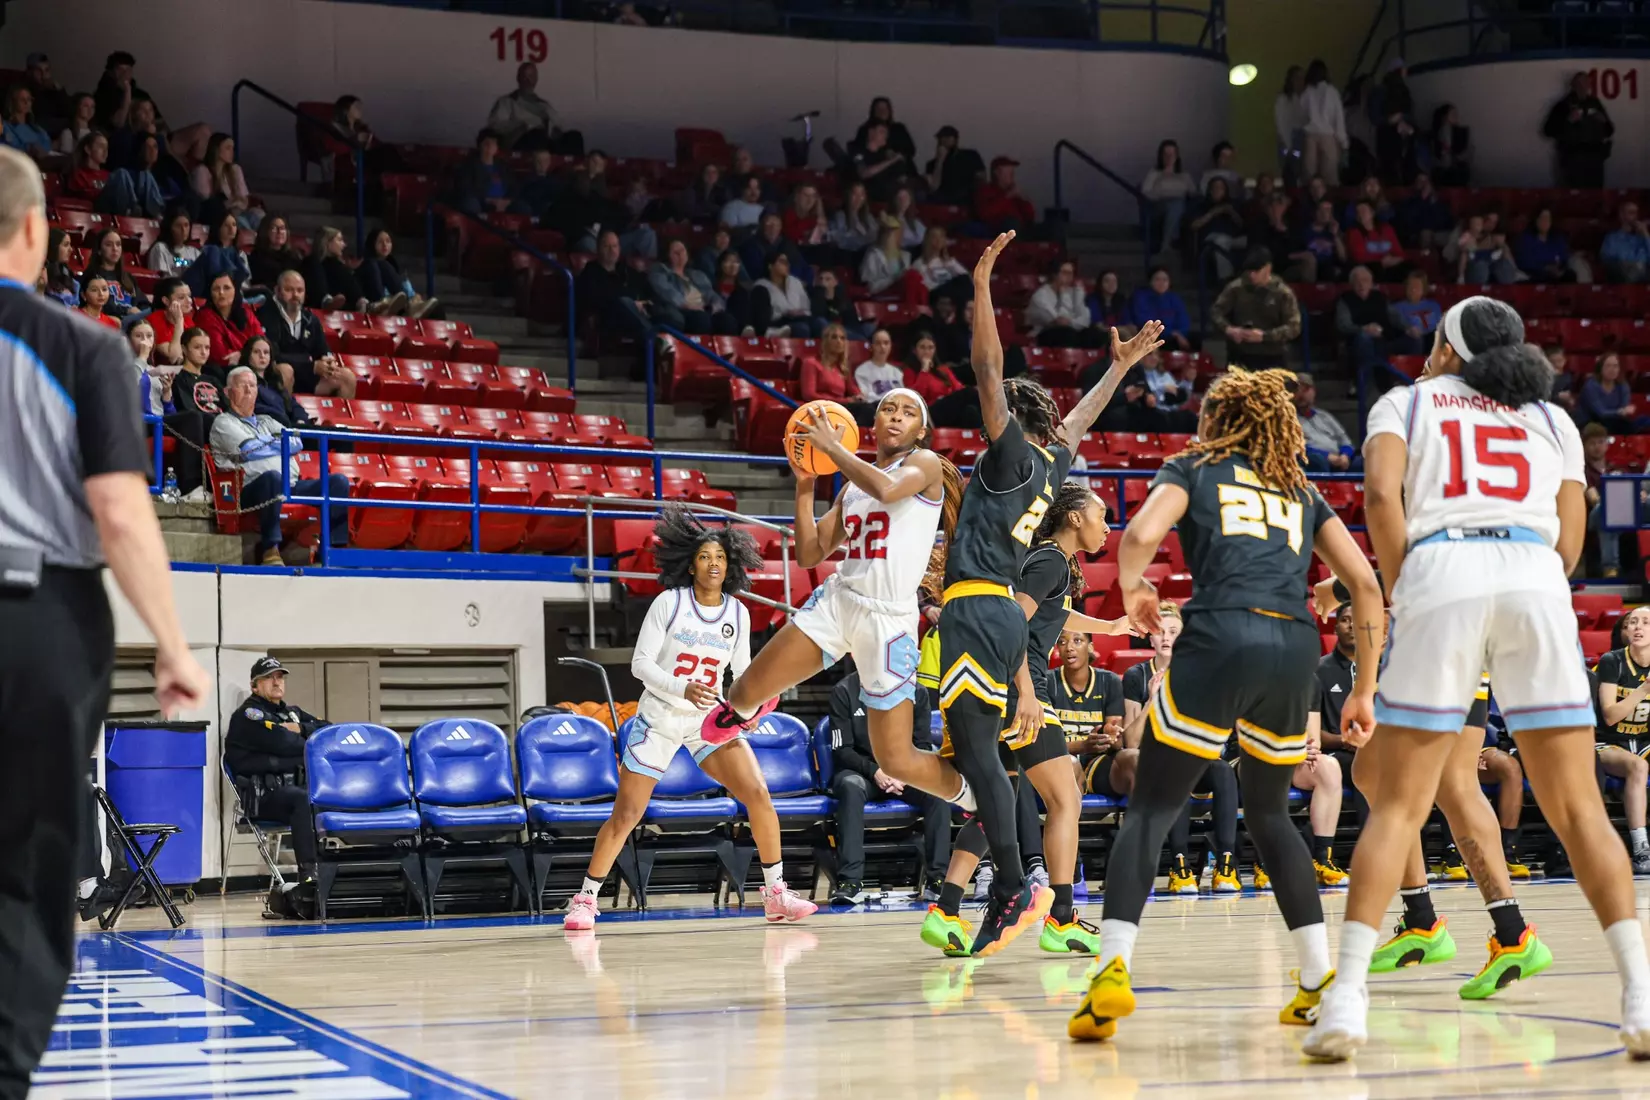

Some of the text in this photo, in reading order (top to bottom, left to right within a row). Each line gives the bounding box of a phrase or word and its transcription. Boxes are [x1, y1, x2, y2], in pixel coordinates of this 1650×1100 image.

[489, 26, 548, 64] 119
[1588, 67, 1637, 100] 101
[1432, 393, 1527, 418] MARSHA
[1440, 420, 1530, 502] 15
[220, 481, 232, 496] T
[845, 511, 890, 560] 22
[1217, 484, 1303, 556] 24
[673, 652, 720, 687] 23
